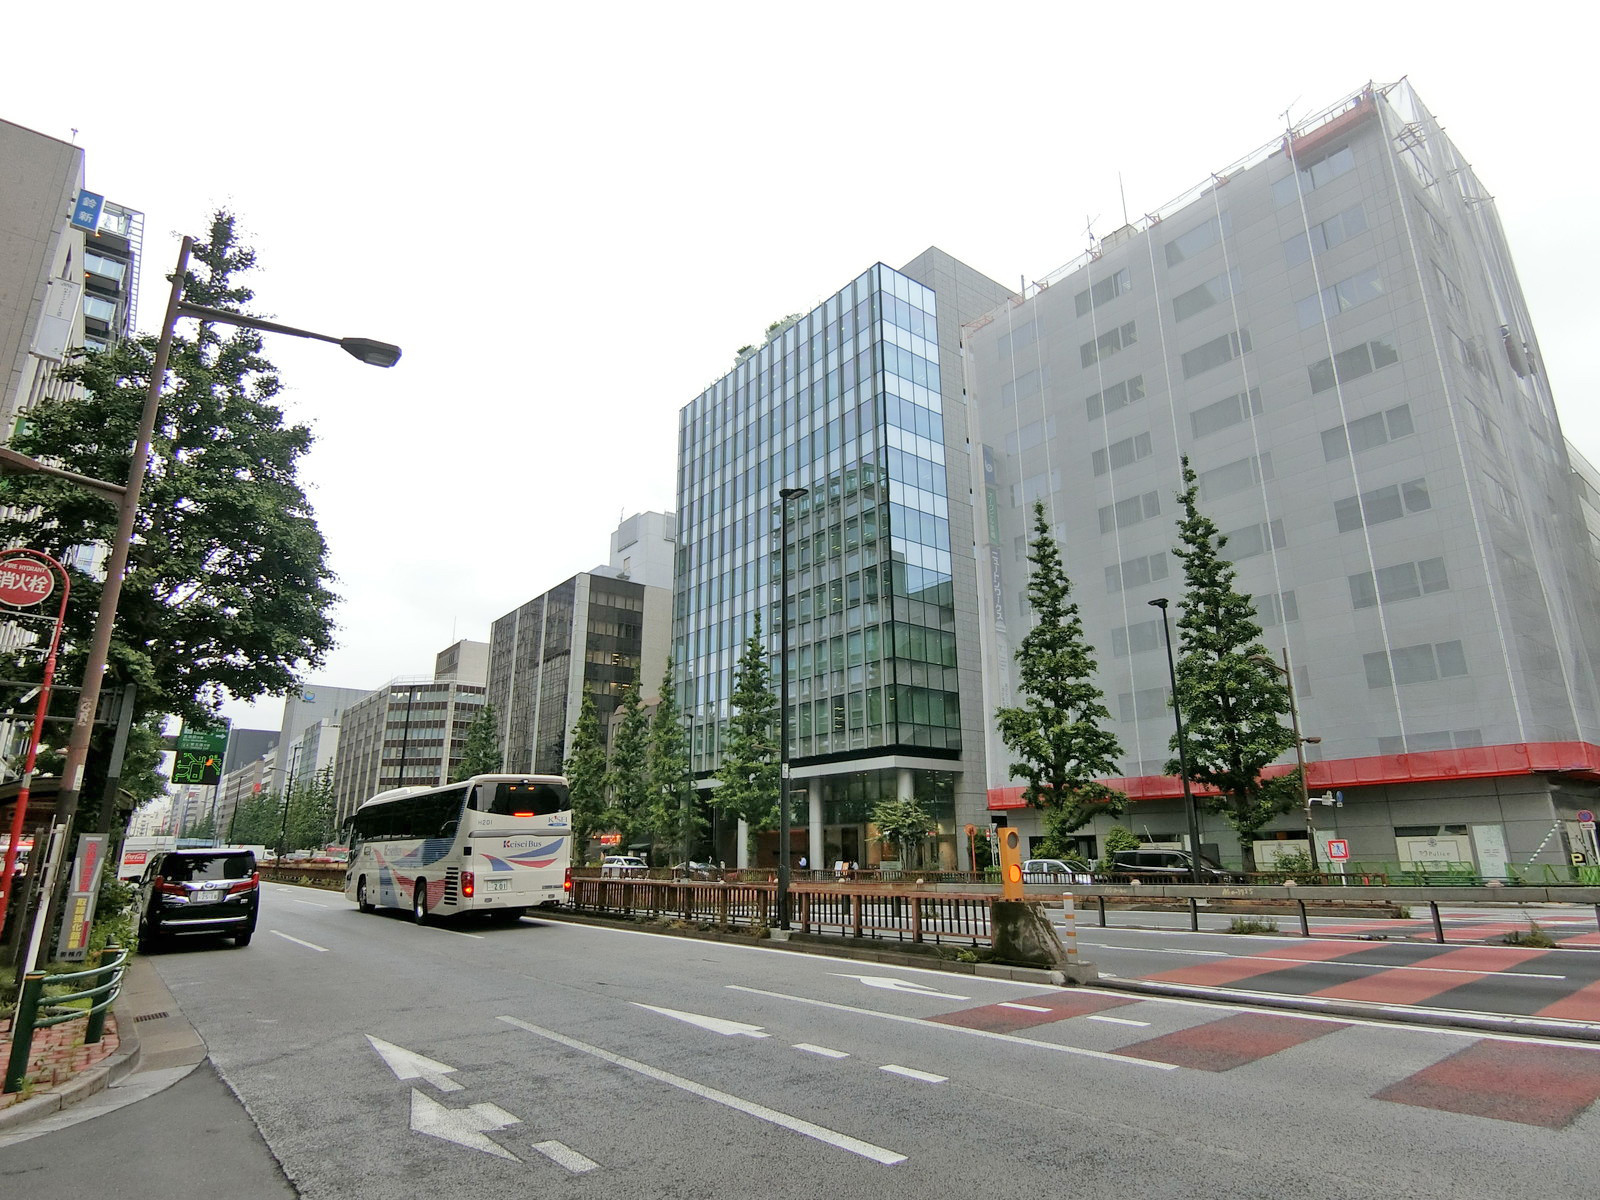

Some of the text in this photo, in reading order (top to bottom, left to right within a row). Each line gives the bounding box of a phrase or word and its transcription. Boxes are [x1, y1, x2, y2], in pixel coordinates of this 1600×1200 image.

[78, 196, 98, 223] 鈴新
[4, 562, 46, 573] FIRE HYDRANT
[0, 571, 48, 593] 消火栓
[503, 840, 542, 848] Keisei Bus
